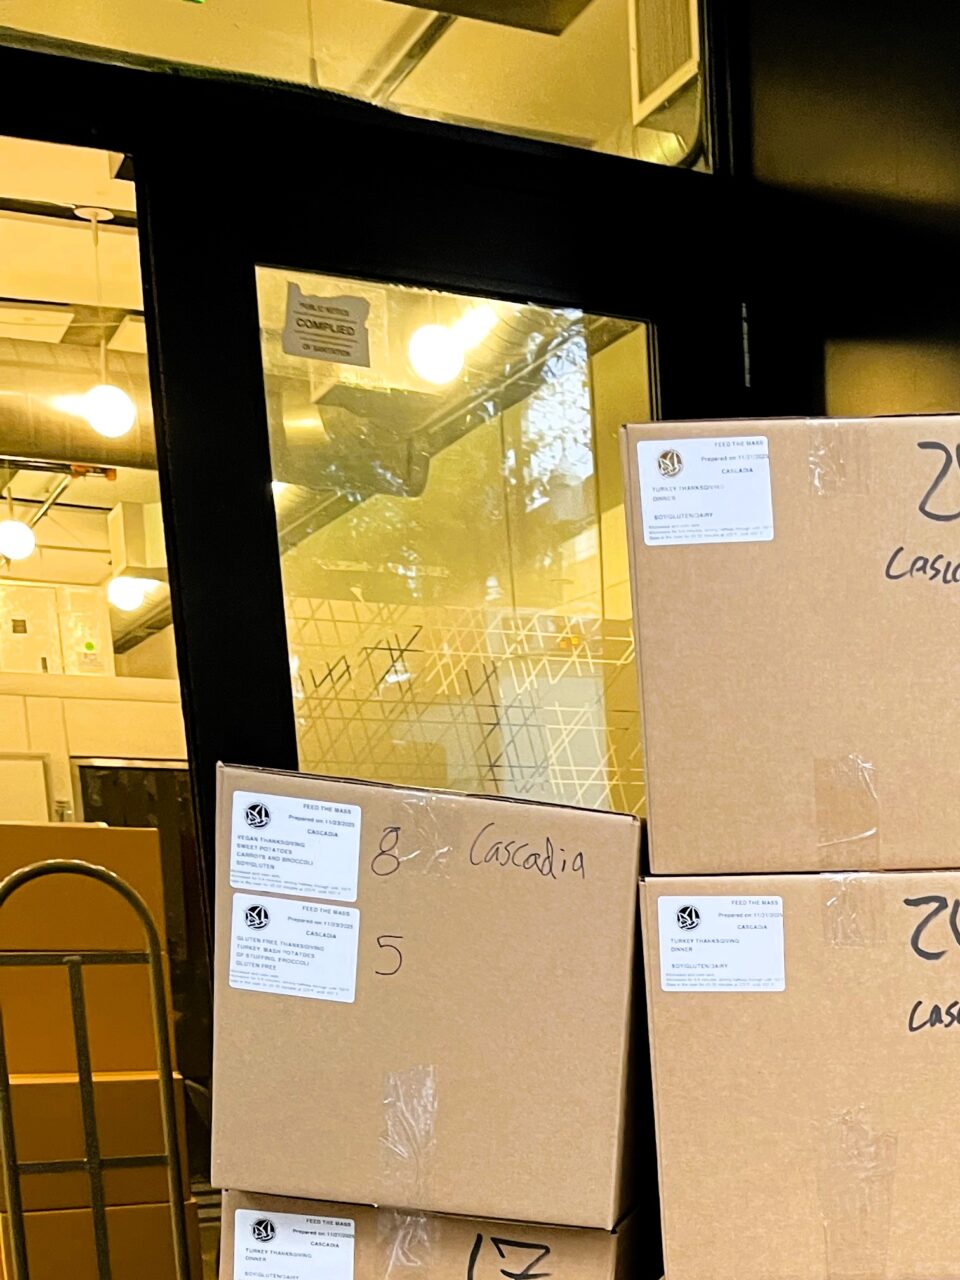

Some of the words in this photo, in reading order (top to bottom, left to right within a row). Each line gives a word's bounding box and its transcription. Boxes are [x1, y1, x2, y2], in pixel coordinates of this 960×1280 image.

[295, 318, 356, 336] COMPLIED
[308, 829, 338, 837] CASCADIA
[260, 837, 305, 847] THANKSGIVING
[260, 846, 292, 854] POTATOES
[371, 827, 401, 876] 8
[469, 822, 585, 879] Cascadia
[282, 857, 313, 865] BROCCOLI
[280, 941, 324, 951] THANKSGIVING
[283, 950, 315, 958] POTATOES
[375, 935, 403, 975] 5
[278, 957, 309, 966] BROCCOLI
